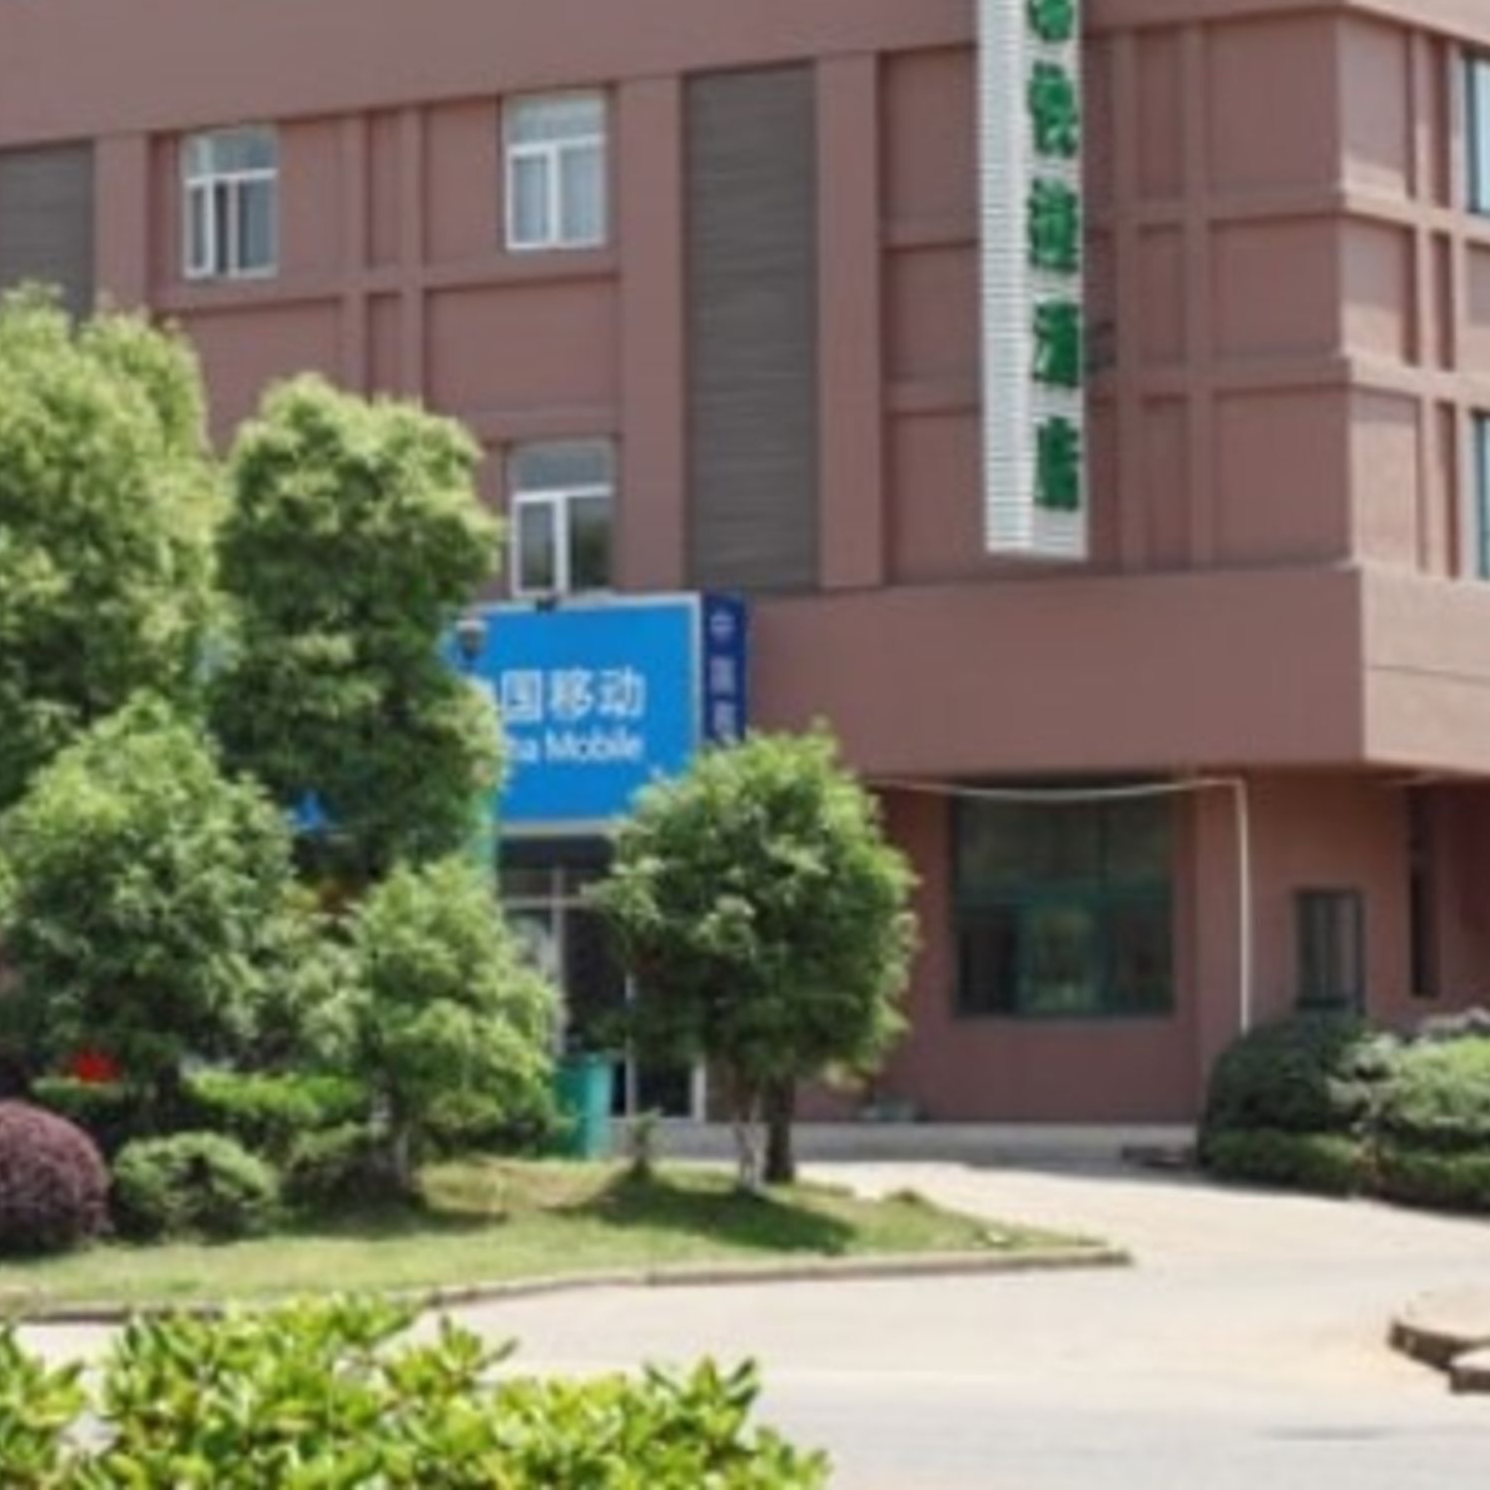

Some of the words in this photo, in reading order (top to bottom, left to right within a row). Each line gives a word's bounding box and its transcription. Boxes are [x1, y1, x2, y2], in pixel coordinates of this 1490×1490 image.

[500, 666, 647, 721] 国移动
[545, 726, 645, 762] Mobile
